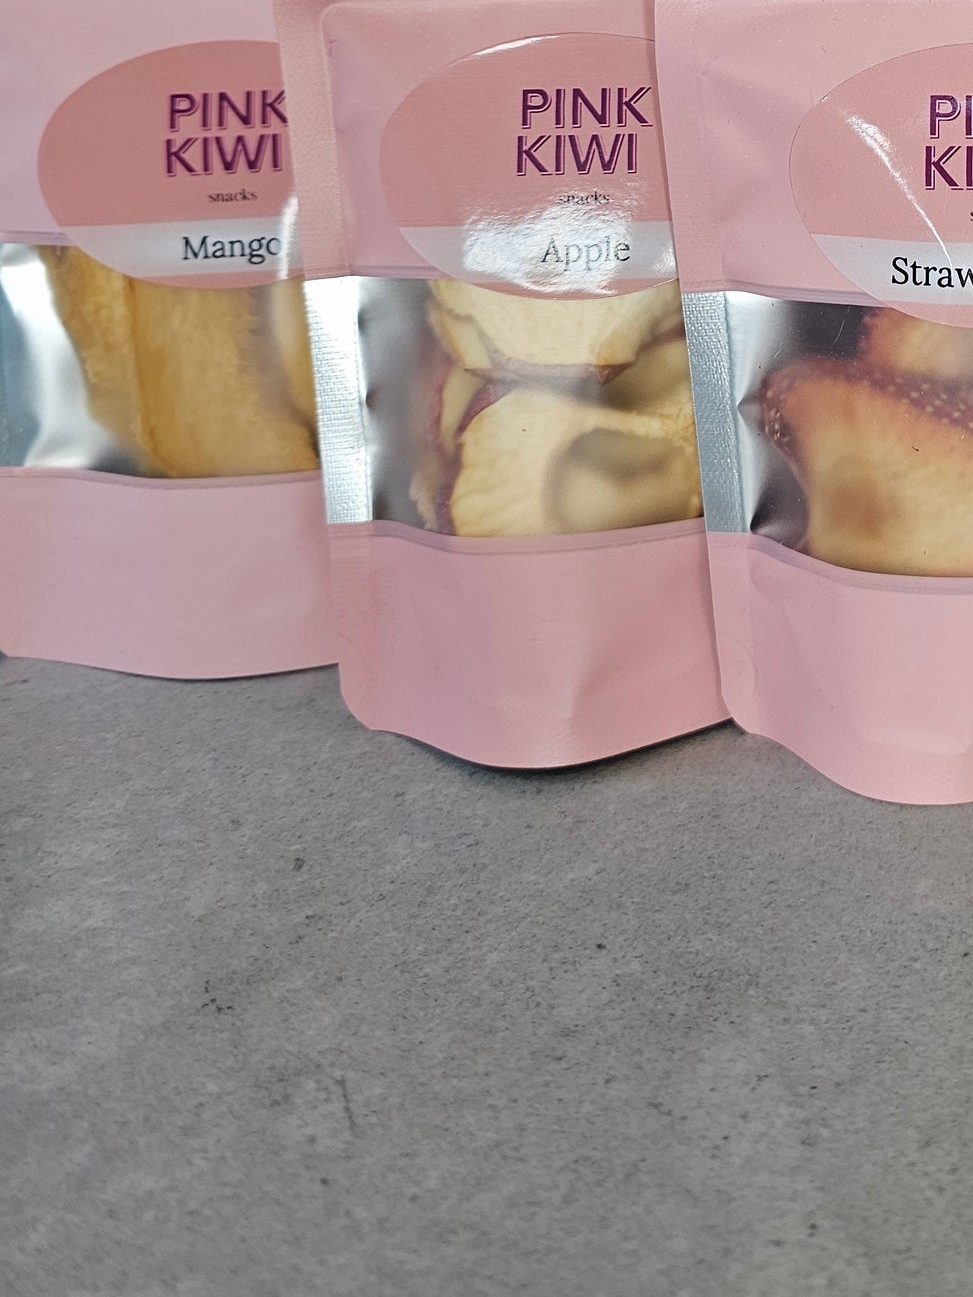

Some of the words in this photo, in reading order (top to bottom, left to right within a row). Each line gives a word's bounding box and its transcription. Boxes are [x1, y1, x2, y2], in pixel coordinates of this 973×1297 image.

[169, 88, 289, 133] PINK
[520, 86, 653, 128] PINK
[165, 132, 283, 177] KIWI
[516, 132, 638, 176] KIWI
[208, 188, 259, 203] snacks
[558, 190, 611, 206] snacks
[182, 234, 283, 265] Mango
[540, 232, 632, 272] Apple
